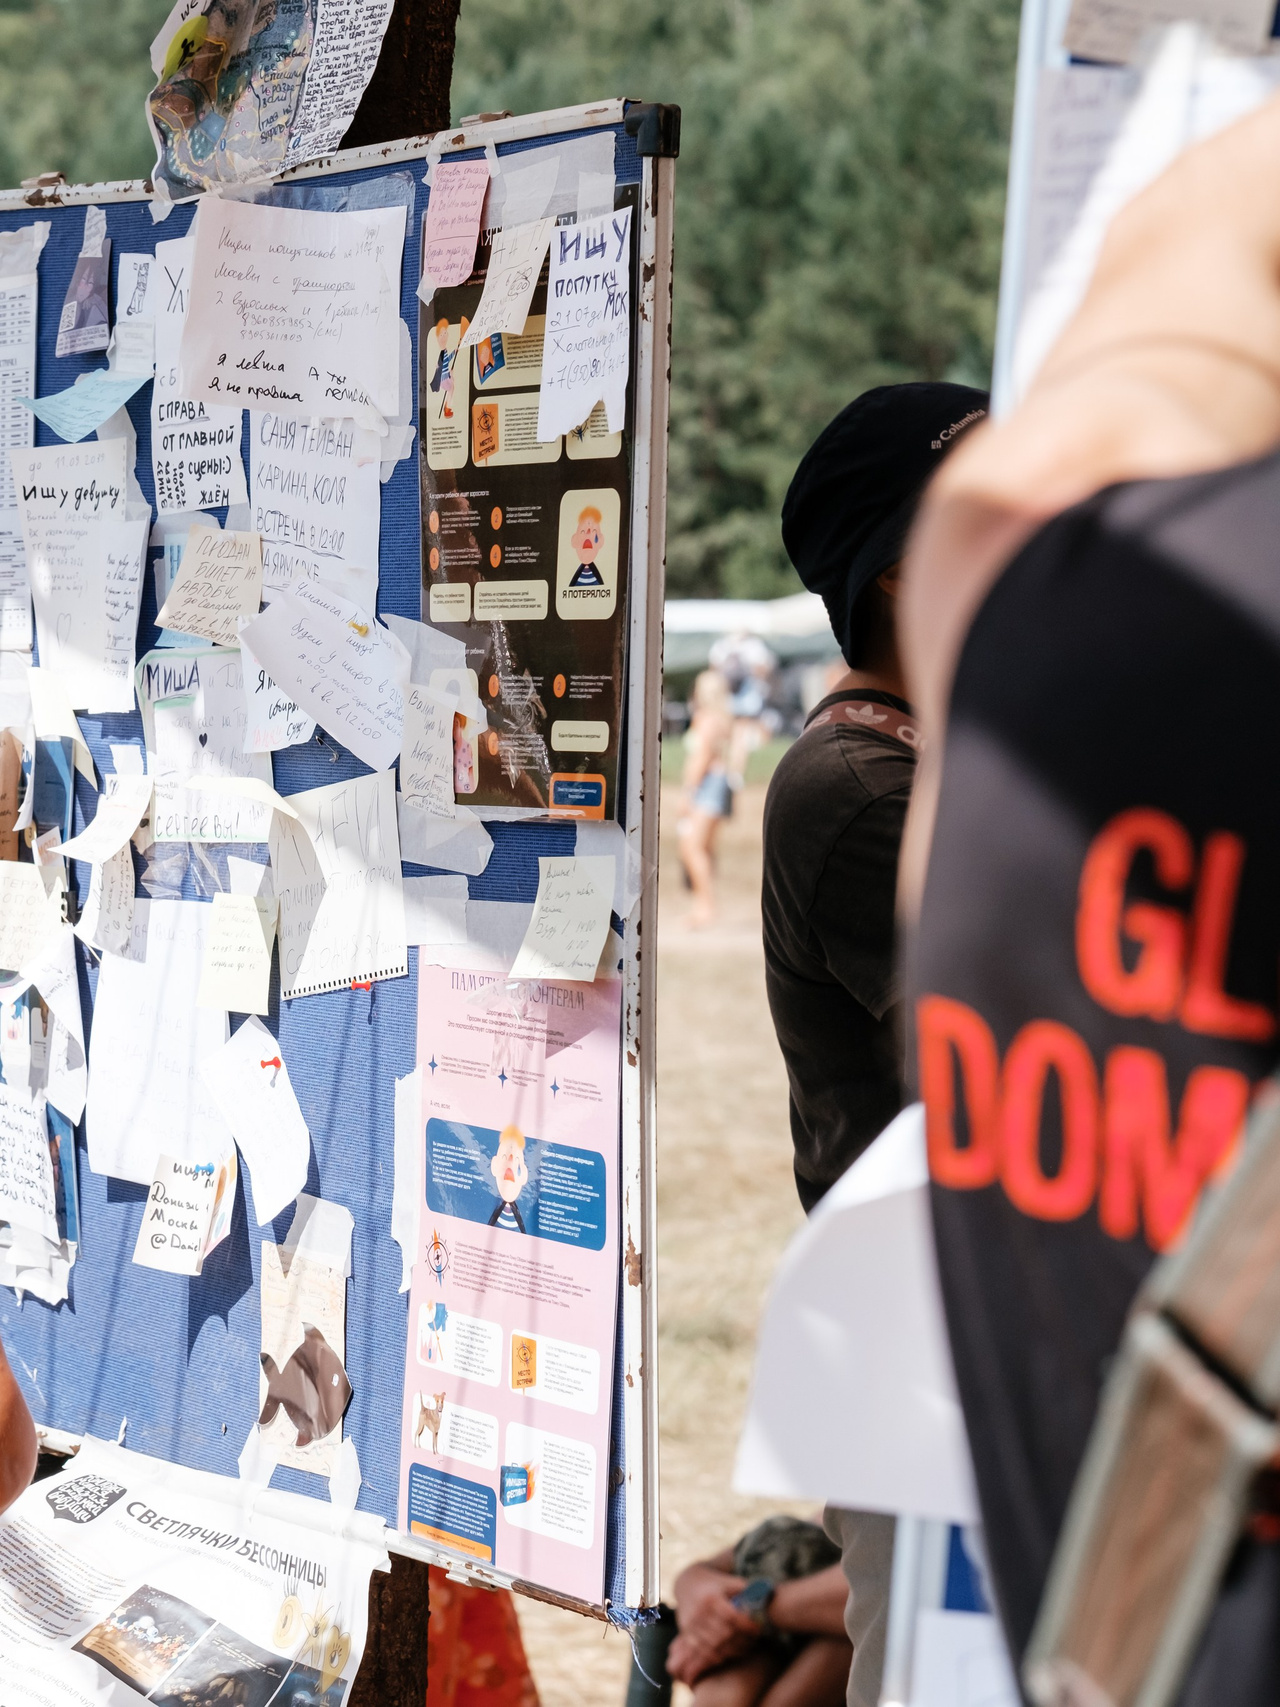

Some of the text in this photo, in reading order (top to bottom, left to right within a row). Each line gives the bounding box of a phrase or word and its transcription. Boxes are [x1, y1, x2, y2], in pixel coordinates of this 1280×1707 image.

[559, 214, 629, 265] ИЩУ
[158, 401, 206, 422] СПРАВА
[939, 407, 987, 441] Columbia
[162, 424, 234, 452] ОТ ГЛАВНОЙ
[260, 413, 297, 450] САНЯ
[198, 484, 230, 507] ЖДЁМ
[256, 506, 306, 542] ВСТРЕЧА
[562, 588, 611, 599] Я ПОТЕРЯЛСЯ
[141, 657, 201, 700] МИША
[126, 1501, 327, 1590] СВЕТЛЯЧКИ БЕССОННИЦЫ
